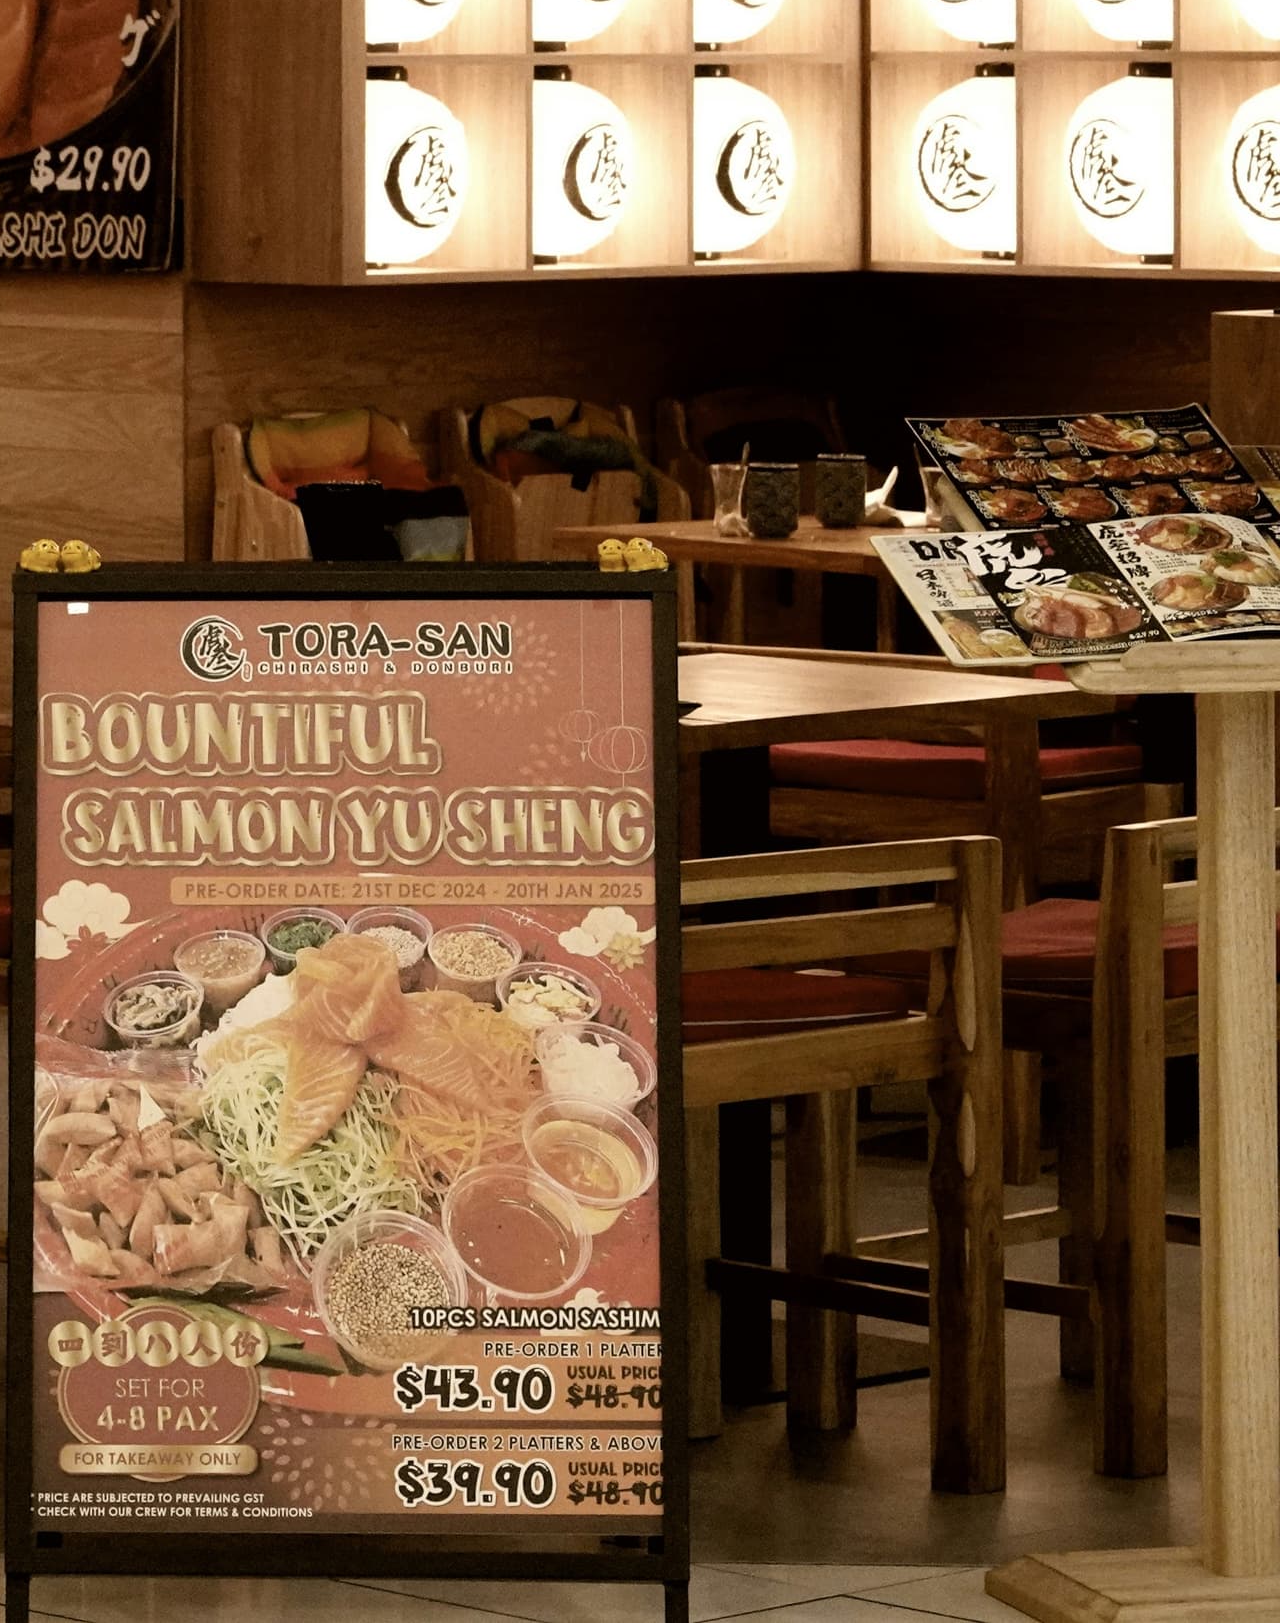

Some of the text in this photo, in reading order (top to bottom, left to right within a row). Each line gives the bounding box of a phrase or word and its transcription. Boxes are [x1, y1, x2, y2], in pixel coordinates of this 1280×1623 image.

[30, 146, 152, 193] $29.90
[72, 213, 146, 259] DON
[259, 623, 512, 659] TORA-SAN
[259, 662, 368, 674] CHIRASHI
[385, 663, 396, 674] &
[412, 662, 513, 674] DONBURI
[47, 699, 433, 769] BOUNTIFUL
[71, 796, 648, 855] SALMON YU SHENG
[185, 883, 288, 899] PRE-ORDER
[294, 883, 345, 899] DATE:
[352, 883, 393, 899] 21ST
[398, 883, 436, 899] DEC
[442, 883, 486, 899] 2024
[505, 883, 548, 899] 20TH
[555, 883, 592, 899] JAN
[598, 883, 643, 899] 2025
[411, 1308, 475, 1328] 10PCS
[481, 1308, 574, 1328] SALMON
[57, 1330, 261, 1359] 四到八人份
[484, 1342, 579, 1358] PRE-ORDER
[585, 1342, 593, 1357] 1
[566, 1365, 664, 1380] USUAL PRIC
[115, 1378, 206, 1398] SET FOR
[394, 1364, 554, 1412] $43.90
[565, 1382, 664, 1409] $48.90
[96, 1405, 220, 1432] 4-8 PAX
[393, 1435, 487, 1451] PRE-ORDER
[493, 1435, 503, 1451] 2
[509, 1435, 584, 1451] PLATTERS
[590, 1435, 601, 1451] &
[74, 1452, 241, 1466] FOR TAKEAWAY ONLY
[568, 1461, 664, 1477] USUAL PRIC
[395, 1459, 556, 1506] $39.90
[567, 1479, 665, 1505] $48.90
[38, 1493, 264, 1503] PRICE ARE SUBJECTED TO PREVAILING GST
[38, 1507, 313, 1517] CHECK WITH OUR CREW FOR TERMS & CONDITIONS
